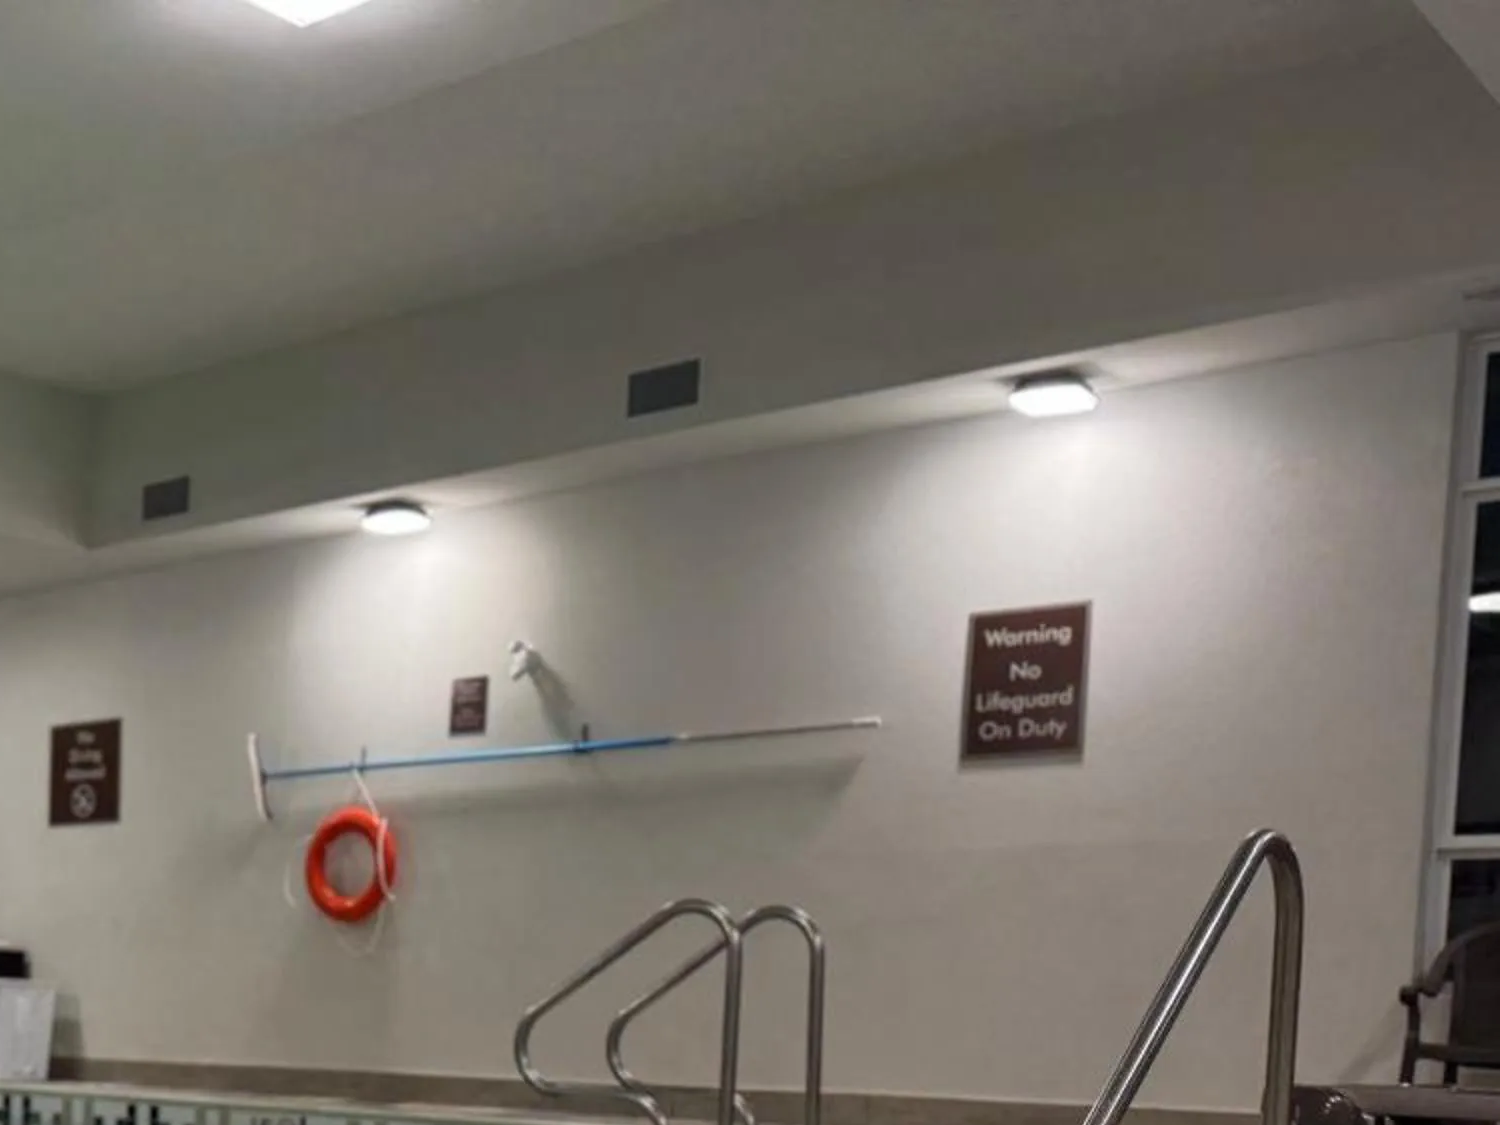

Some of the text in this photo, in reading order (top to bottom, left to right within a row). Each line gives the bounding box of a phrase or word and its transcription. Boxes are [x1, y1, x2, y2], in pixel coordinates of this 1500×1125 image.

[984, 623, 1073, 648] Warning
[1008, 660, 1043, 682] No
[974, 684, 1076, 714] Lifeguard
[977, 717, 1068, 742] On Duty
